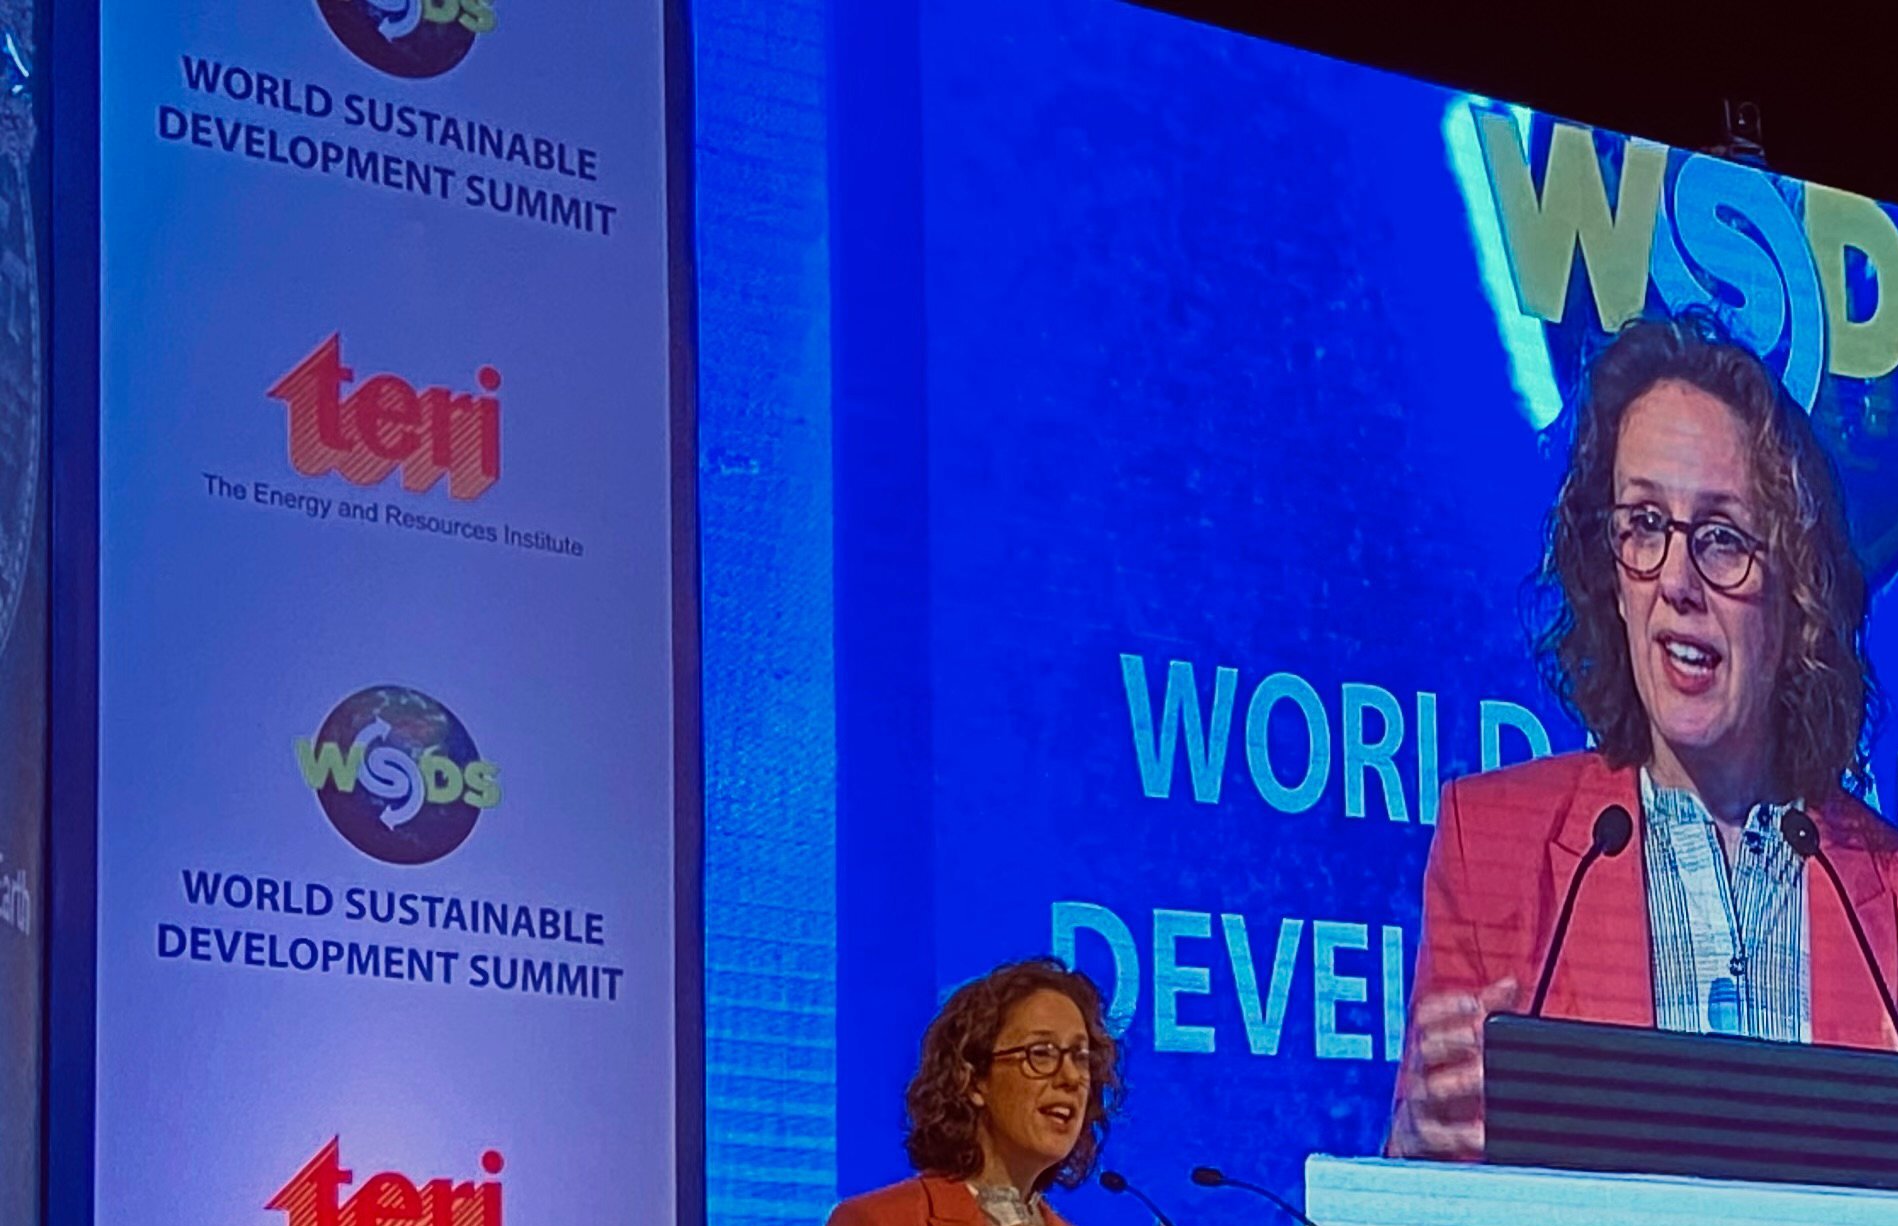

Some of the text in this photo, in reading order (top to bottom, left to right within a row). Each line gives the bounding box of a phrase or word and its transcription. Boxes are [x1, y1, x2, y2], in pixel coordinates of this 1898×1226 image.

[158, 105, 617, 236] DEVELOPMENT SUMMIT
[182, 54, 598, 181] WORLD SUSTAINABLE
[266, 331, 501, 500] teri
[202, 472, 584, 557] The Energy and Resources Institute
[157, 922, 623, 1000] DEVELOPMENT SUMMIT
[183, 869, 605, 947] WORLD SUSTAINABLE
